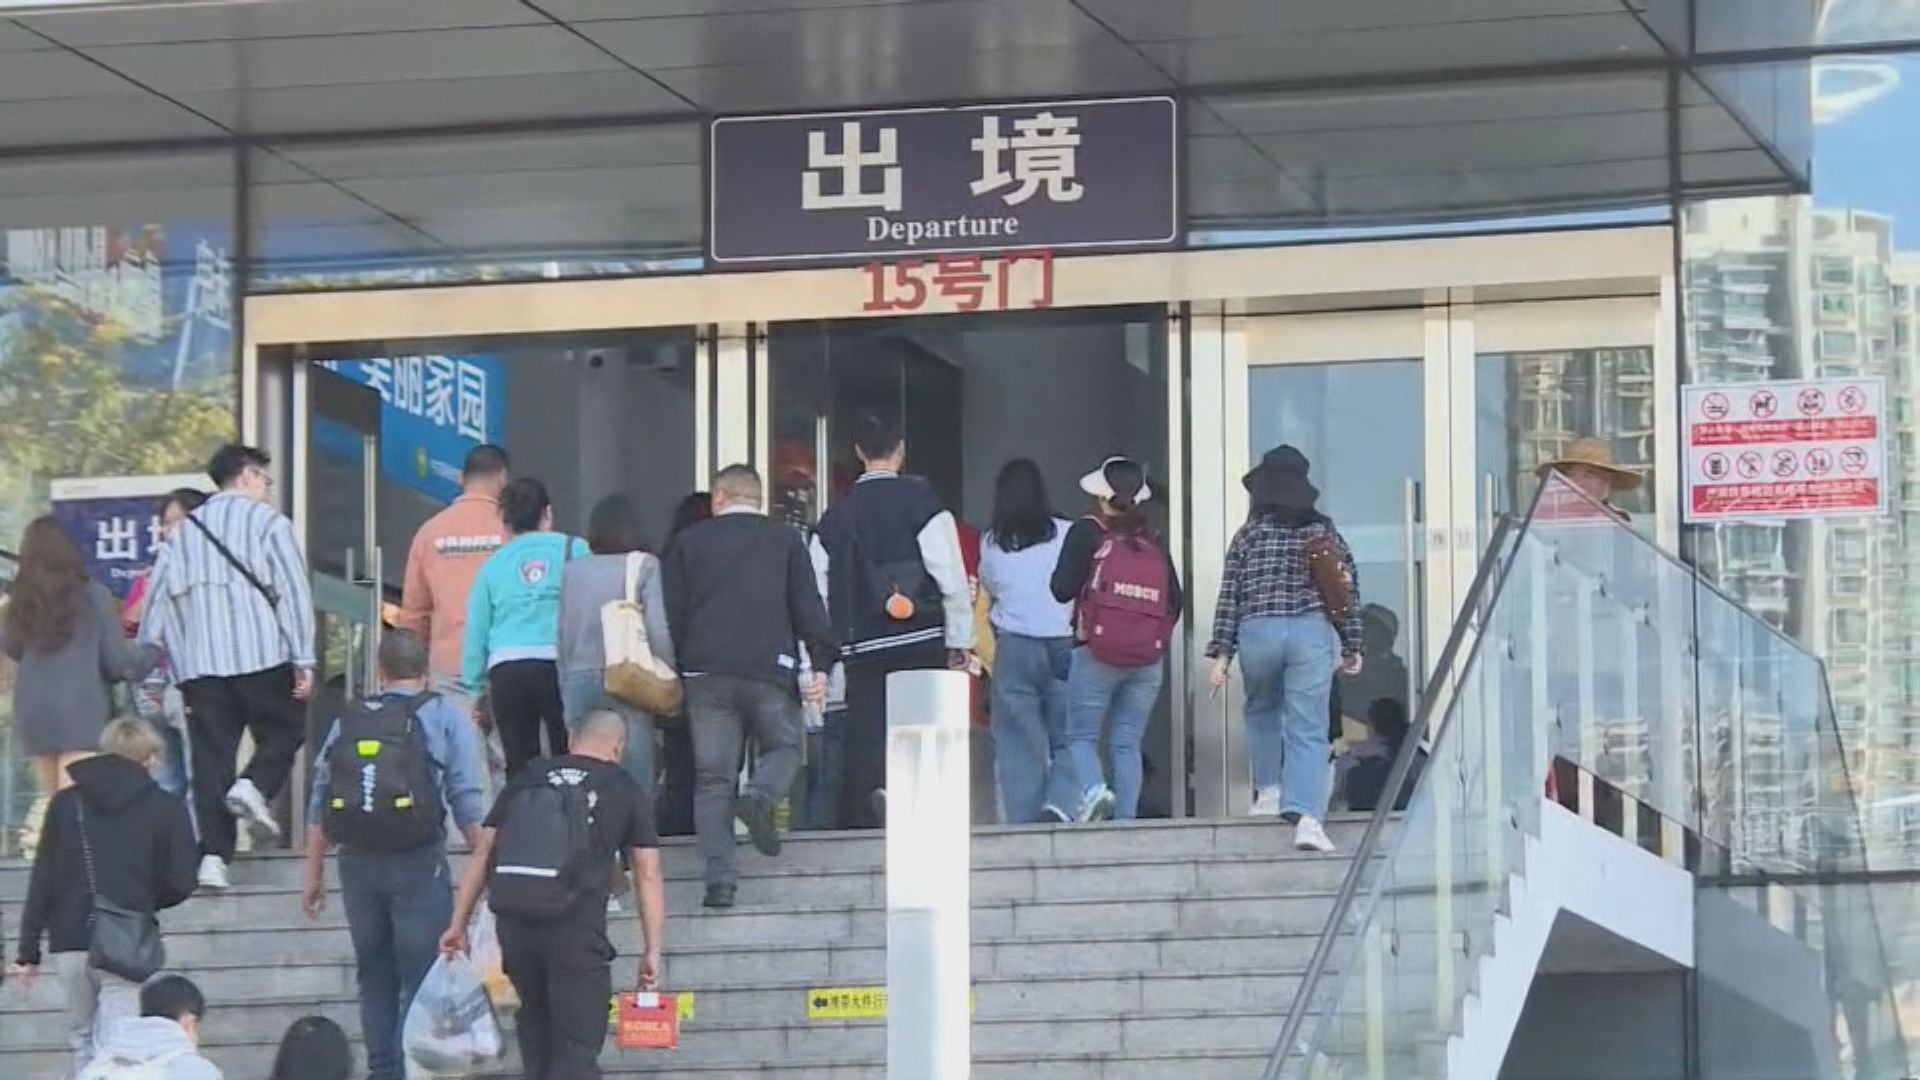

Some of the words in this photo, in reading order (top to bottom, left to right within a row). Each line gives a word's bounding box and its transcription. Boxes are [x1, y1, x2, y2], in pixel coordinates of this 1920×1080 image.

[802, 112, 1084, 211] 出境
[866, 215, 1019, 245] Departure
[862, 248, 1055, 312] 15号门
